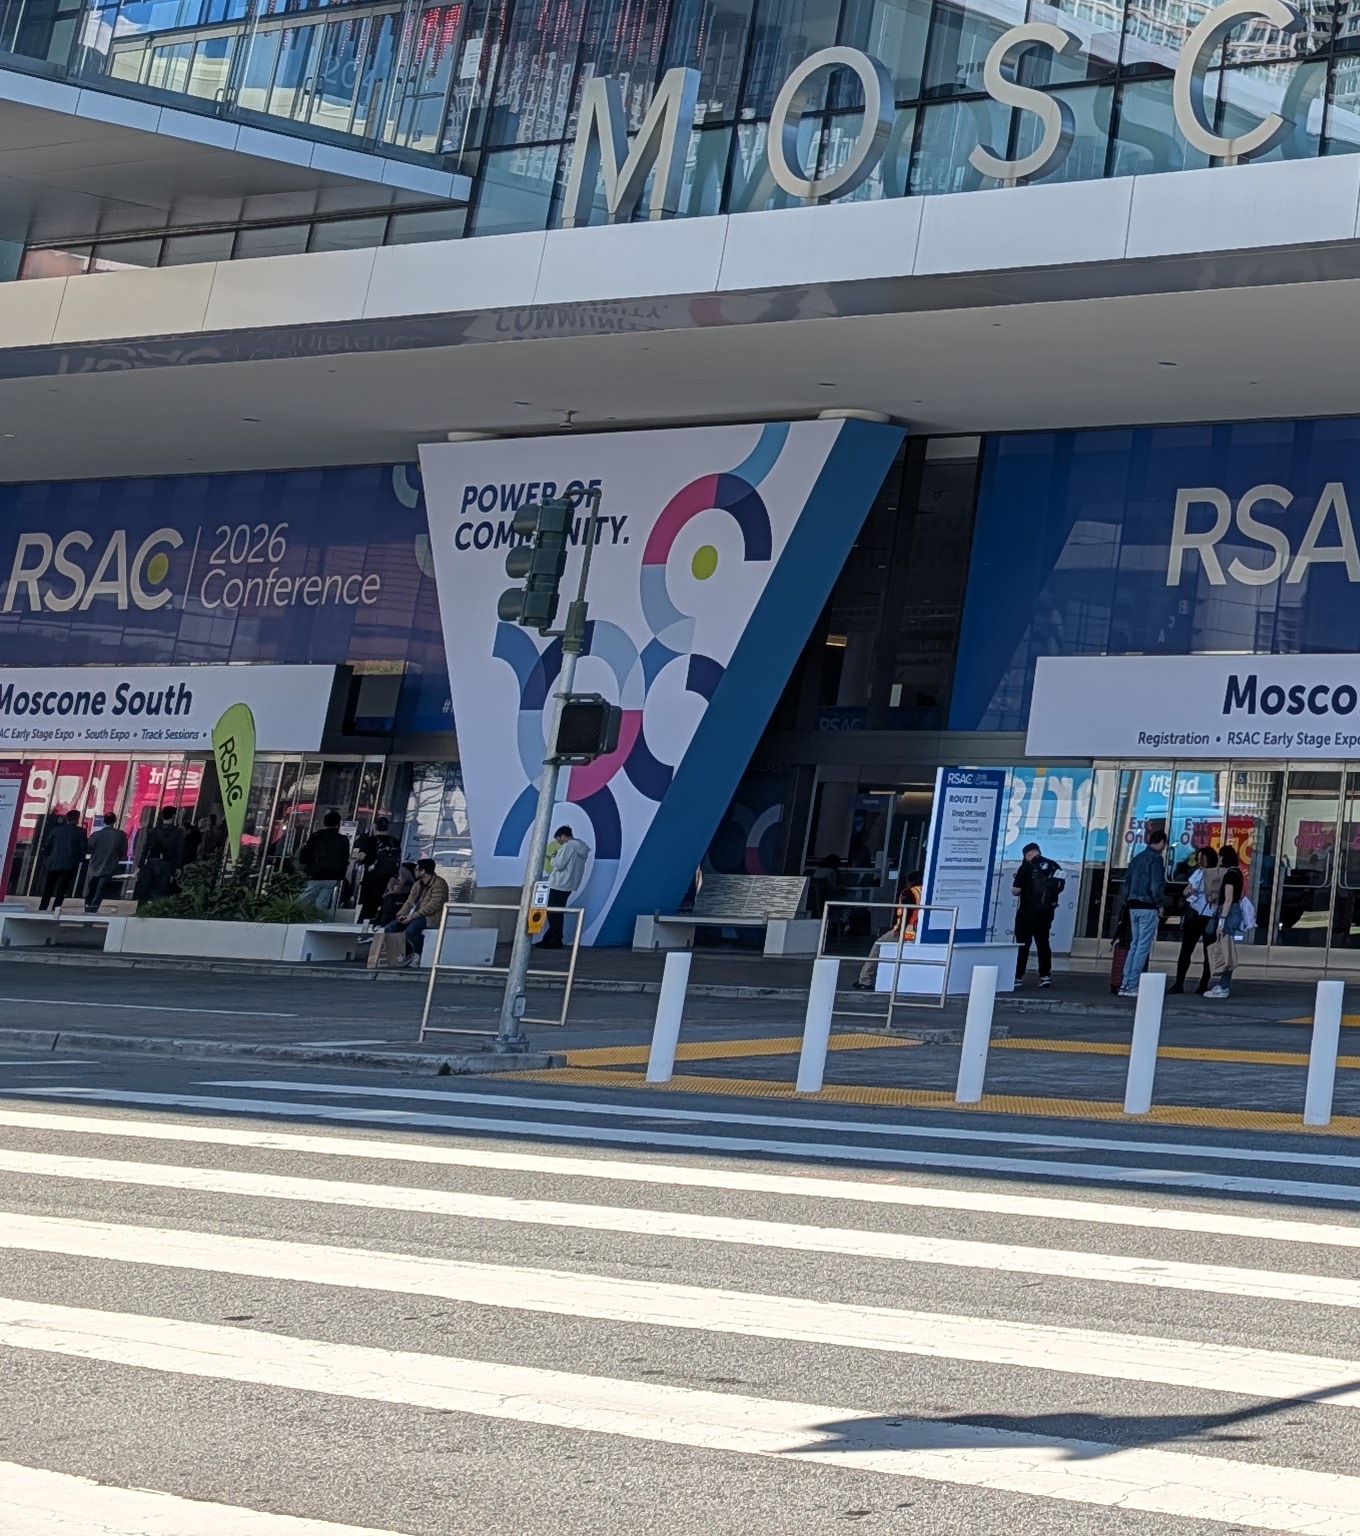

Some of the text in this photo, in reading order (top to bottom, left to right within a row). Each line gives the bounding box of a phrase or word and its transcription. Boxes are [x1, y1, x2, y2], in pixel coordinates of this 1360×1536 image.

[209, 522, 290, 565] 2026
[455, 515, 630, 551] COMNITY.
[3, 527, 184, 612] RSAC
[200, 567, 381, 609] Conference
[112, 682, 193, 715] South
[11, 728, 31, 741] Early
[32, 728, 53, 741] Stage
[54, 728, 75, 741] Expo
[85, 728, 109, 739] South
[110, 728, 130, 742] Expo
[142, 729, 163, 739] Track
[164, 728, 200, 739] Sessions
[1138, 731, 1210, 748] Registration
[1227, 732, 1261, 745] RSAC
[1263, 732, 1294, 748] Early
[1297, 732, 1331, 749] Stage
[219, 736, 243, 807] RSAC
[947, 773, 973, 785] RSAC
[949, 795, 972, 803] ROUTE
